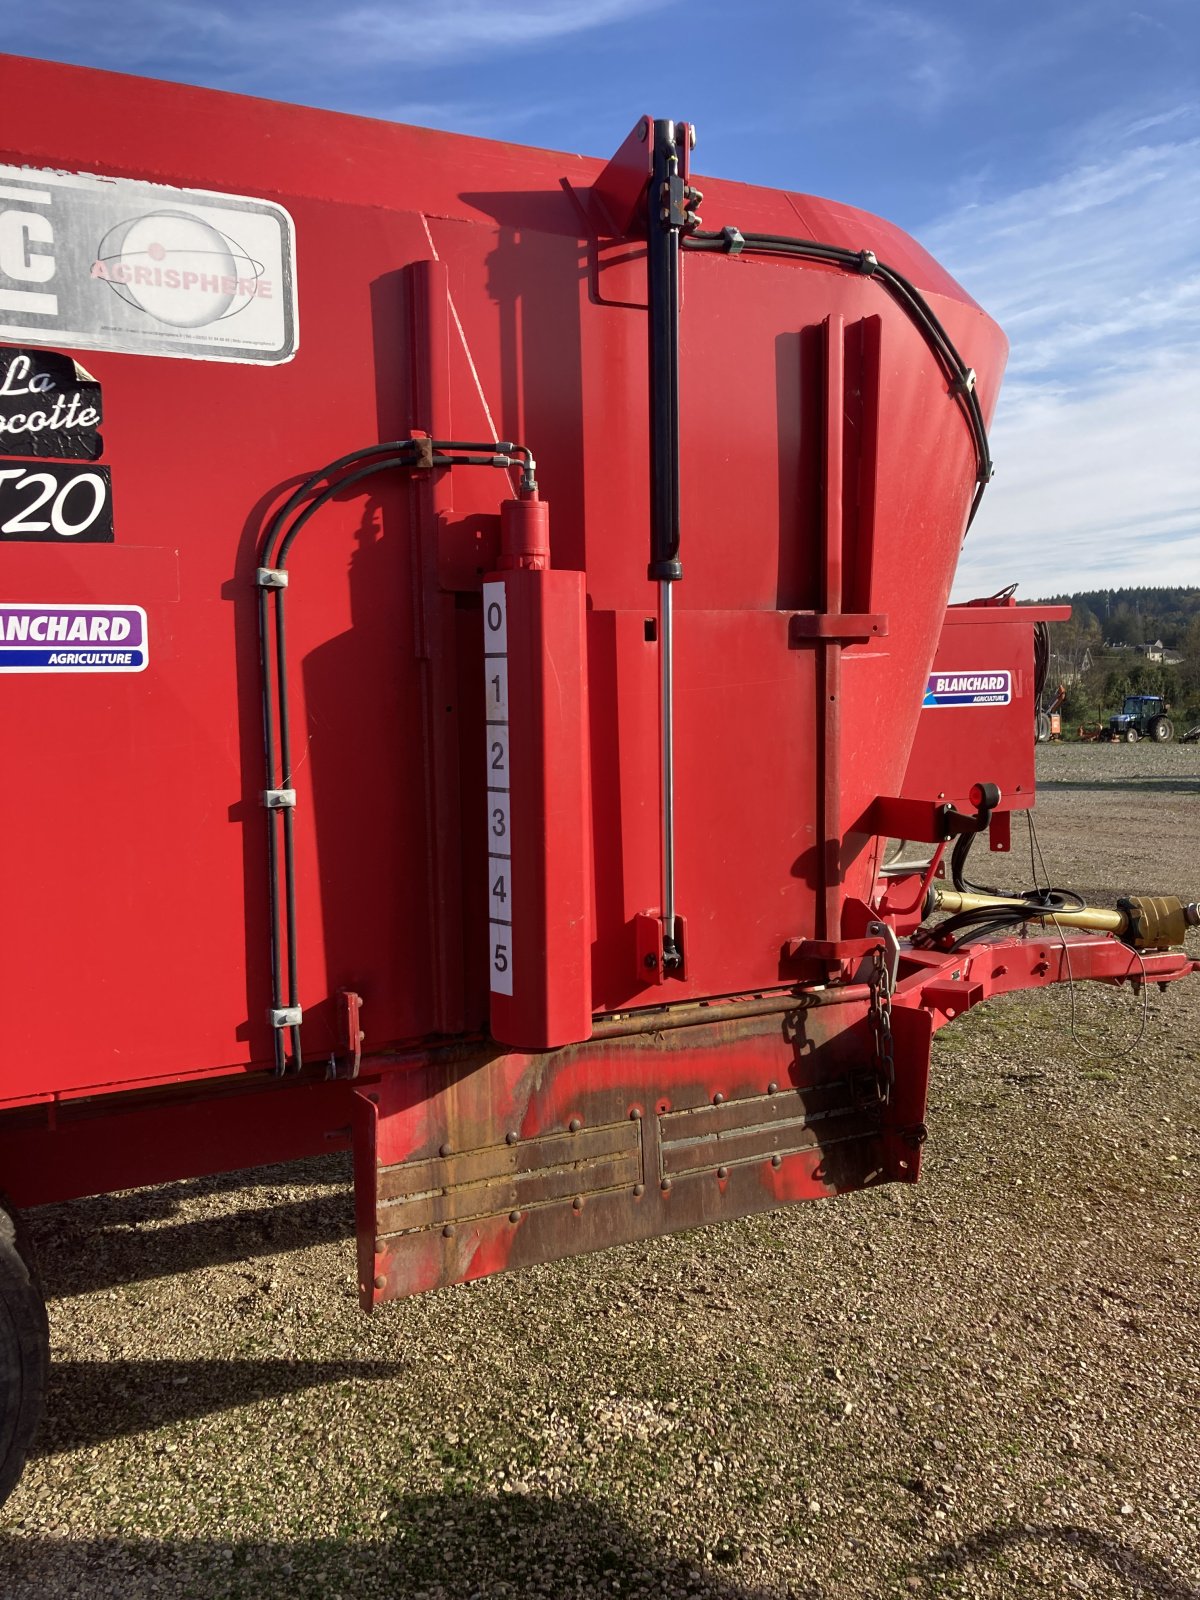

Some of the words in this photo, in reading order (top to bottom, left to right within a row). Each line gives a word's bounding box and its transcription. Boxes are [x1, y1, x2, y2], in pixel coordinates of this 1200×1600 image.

[90, 259, 273, 299] AGRISPHERE
[0, 355, 56, 396] La
[0, 615, 131, 642] NCHARD
[487, 602, 502, 632] 0
[48, 653, 132, 665] AGRICULTURE
[491, 674, 501, 703] 1
[936, 676, 1004, 692] BLANCHARD
[490, 741, 505, 771] 2
[491, 808, 506, 838] 3
[492, 875, 507, 903] 4
[494, 944, 508, 973] 5
